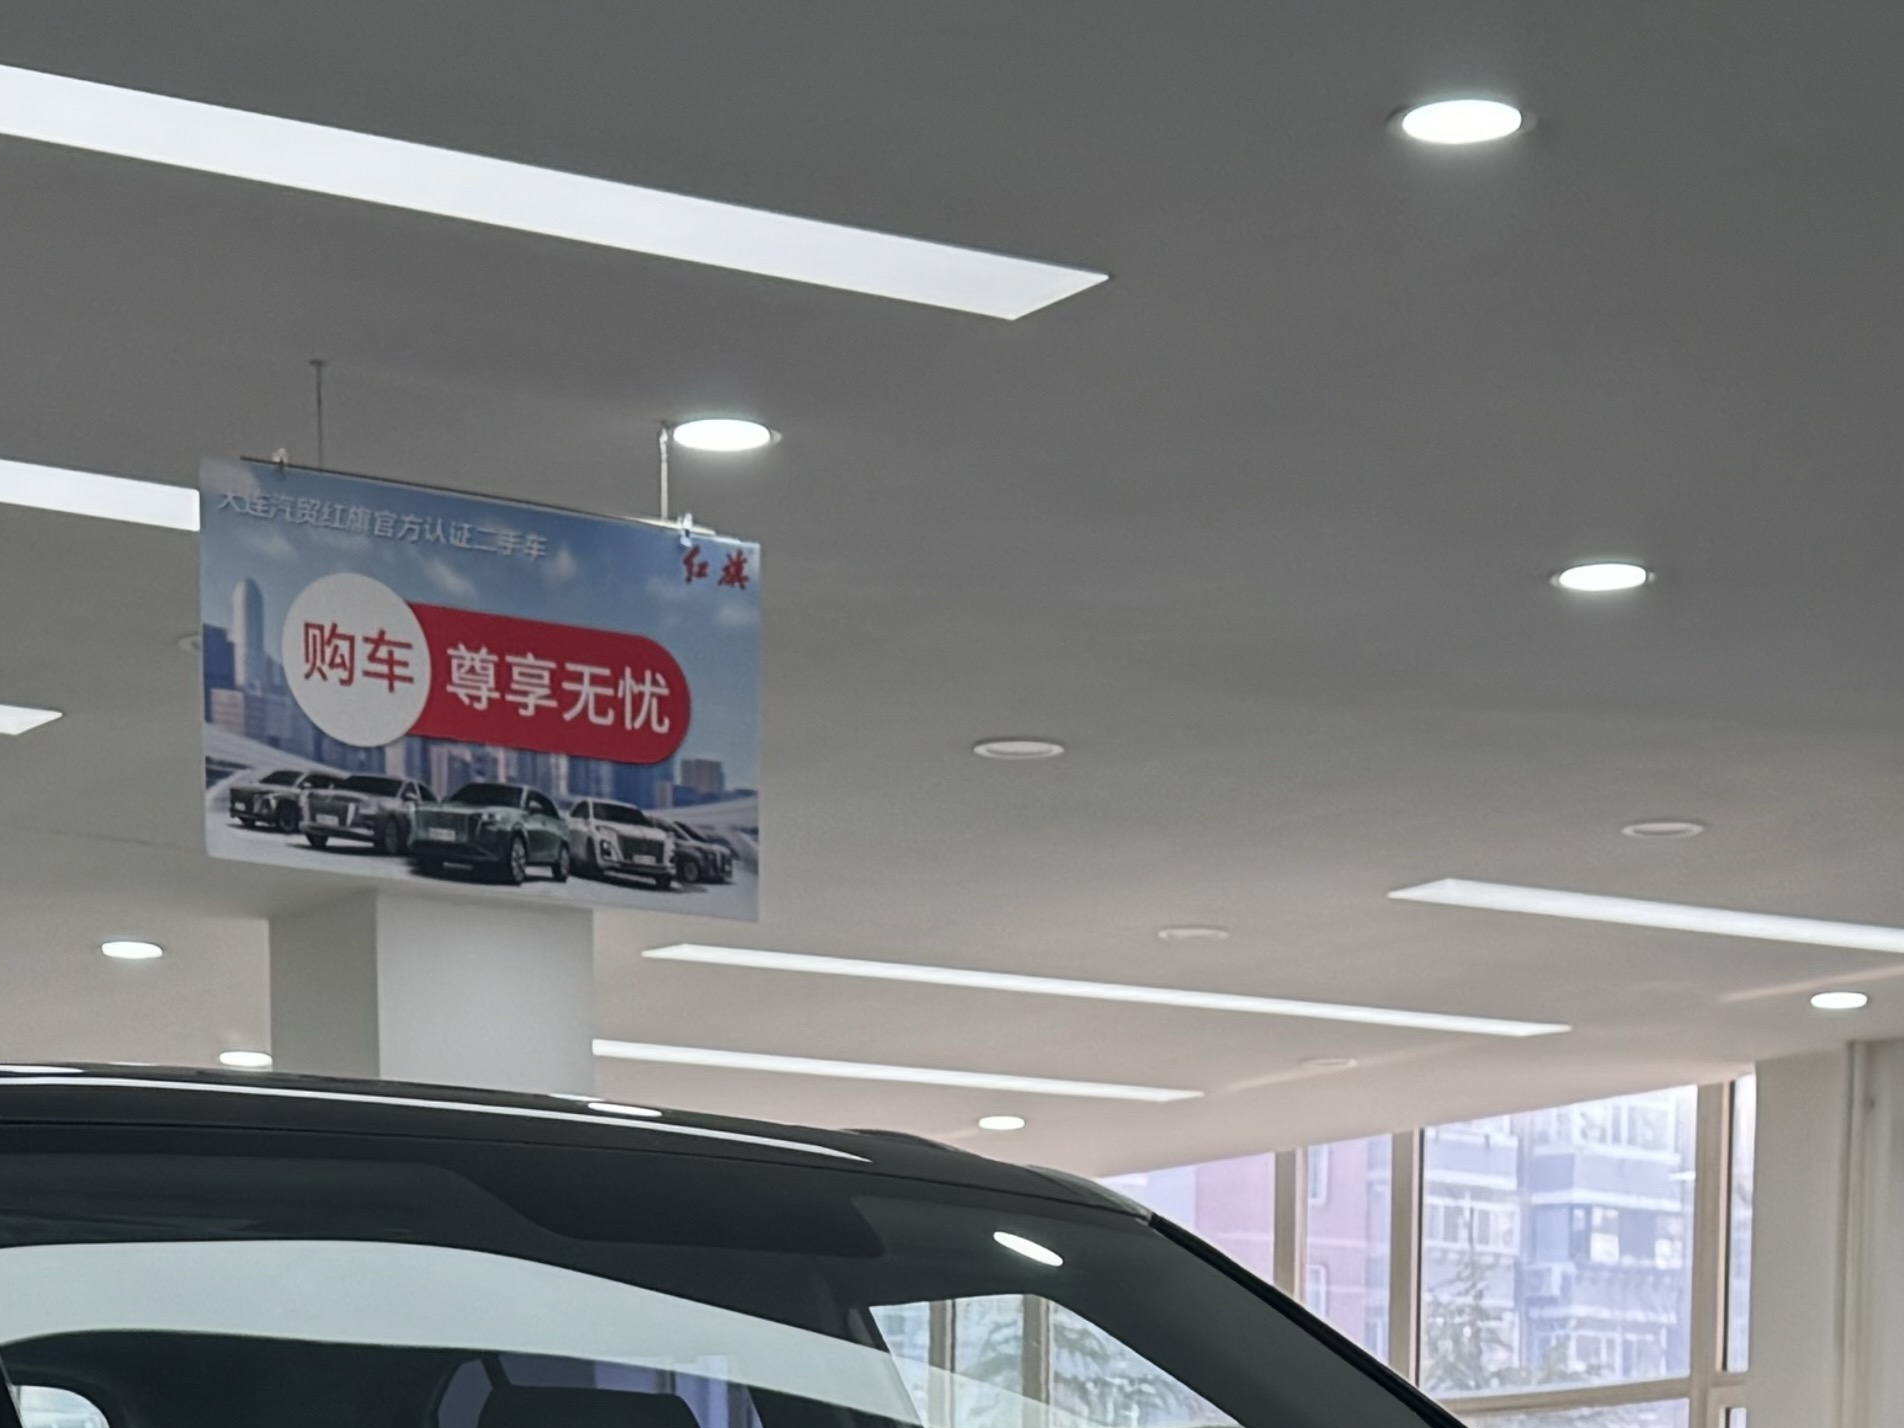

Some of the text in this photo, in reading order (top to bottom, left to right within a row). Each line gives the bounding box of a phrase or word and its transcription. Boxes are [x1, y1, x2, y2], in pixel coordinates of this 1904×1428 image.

[683, 546, 751, 591] 红旗
[302, 620, 671, 734] 购车 尊享无忧
